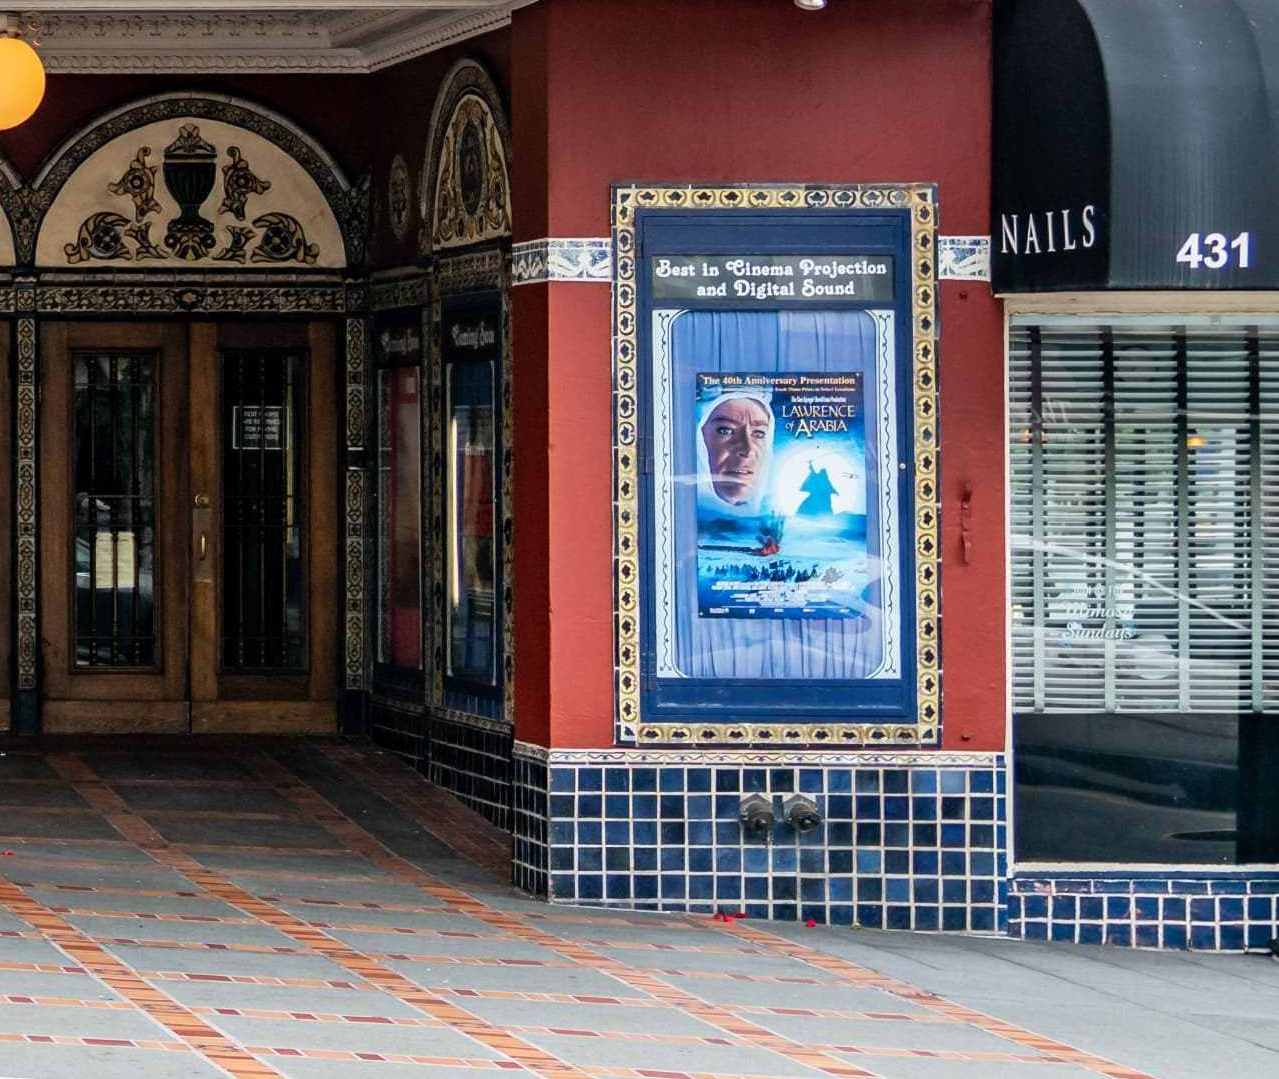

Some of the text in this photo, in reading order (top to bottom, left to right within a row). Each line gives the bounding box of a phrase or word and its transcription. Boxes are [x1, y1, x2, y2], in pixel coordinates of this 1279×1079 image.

[1000, 204, 1096, 256] NAILS
[1175, 231, 1250, 269] 431
[655, 259, 887, 279] Best in Cinema Projection
[696, 278, 855, 300] and Digital Sound
[703, 376, 855, 386] The 40th Anniversary Presentation
[782, 405, 855, 418] LAWRENCE
[786, 419, 848, 437] of ARABIA
[1062, 621, 1133, 643] Sundays
